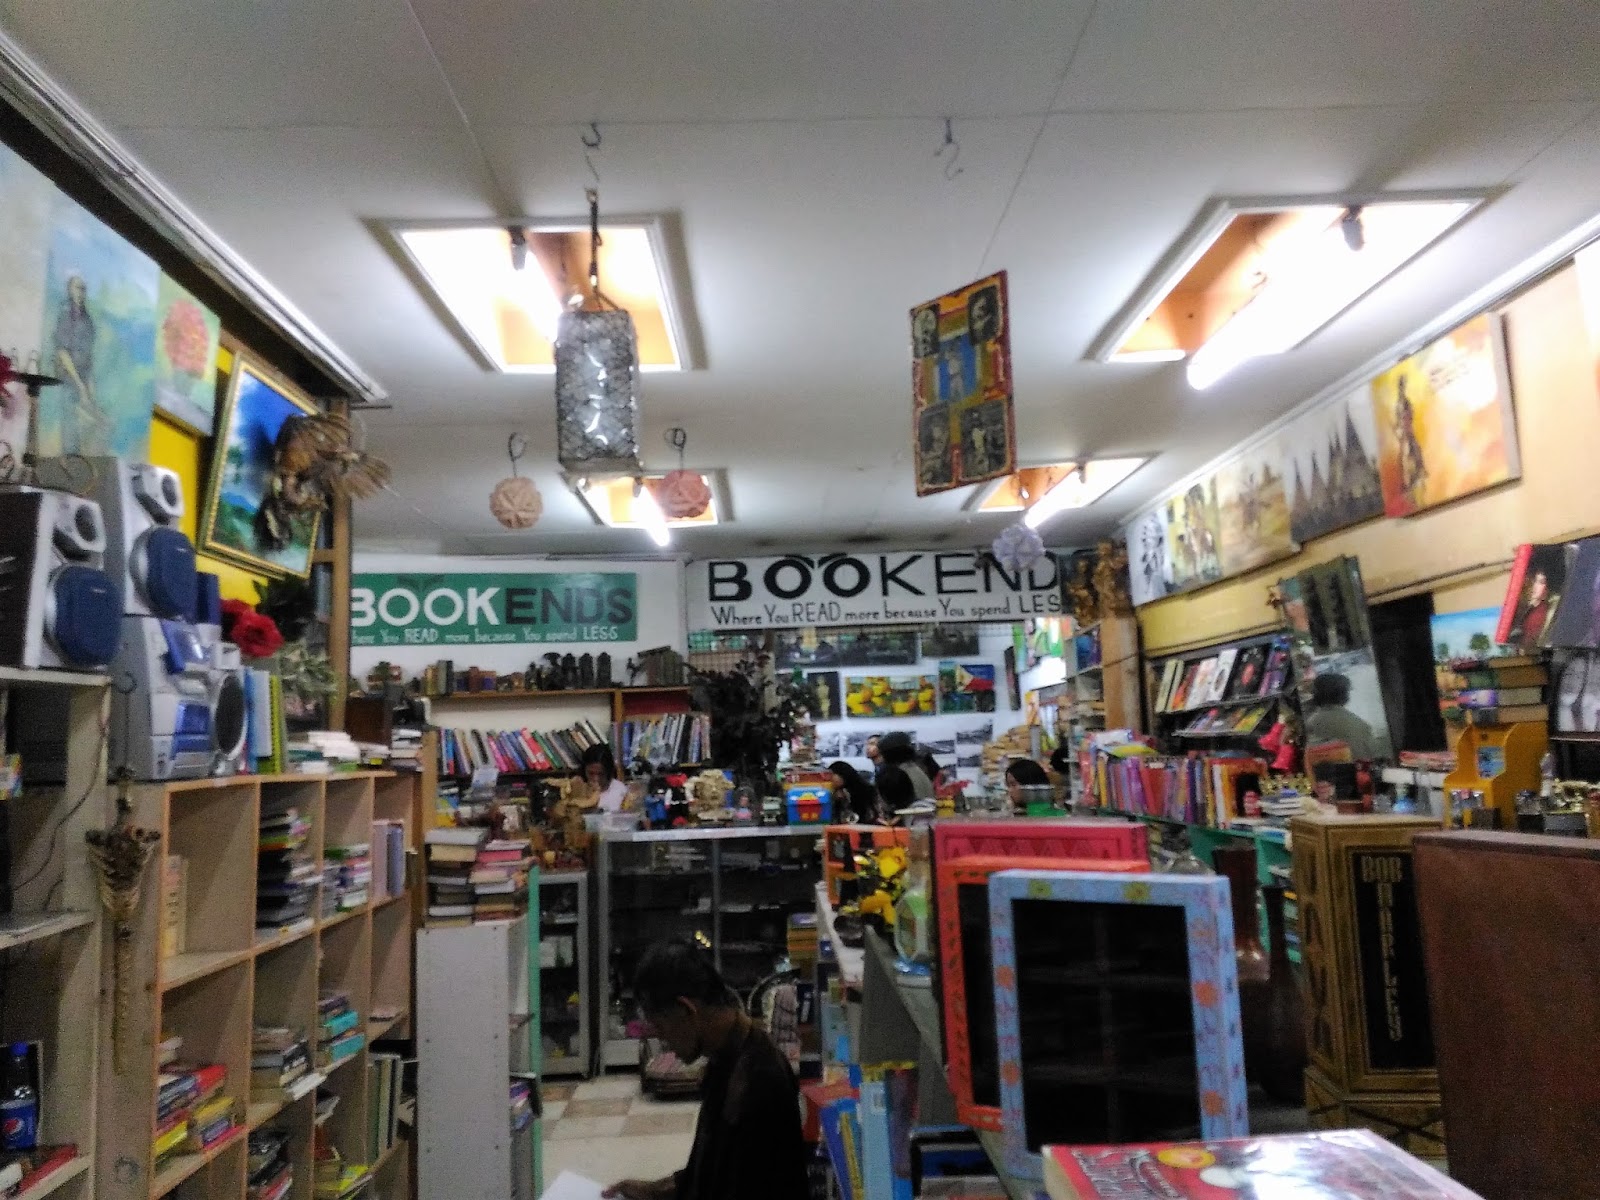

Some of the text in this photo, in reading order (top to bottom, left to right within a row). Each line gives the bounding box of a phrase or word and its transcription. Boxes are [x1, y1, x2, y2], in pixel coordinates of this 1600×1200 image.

[708, 550, 1059, 602] BOOKEND
[351, 587, 633, 627] BOOKENDS
[711, 594, 1061, 625] Where You READ more because You spend LES
[404, 628, 438, 643] READ
[582, 625, 619, 641] LESS
